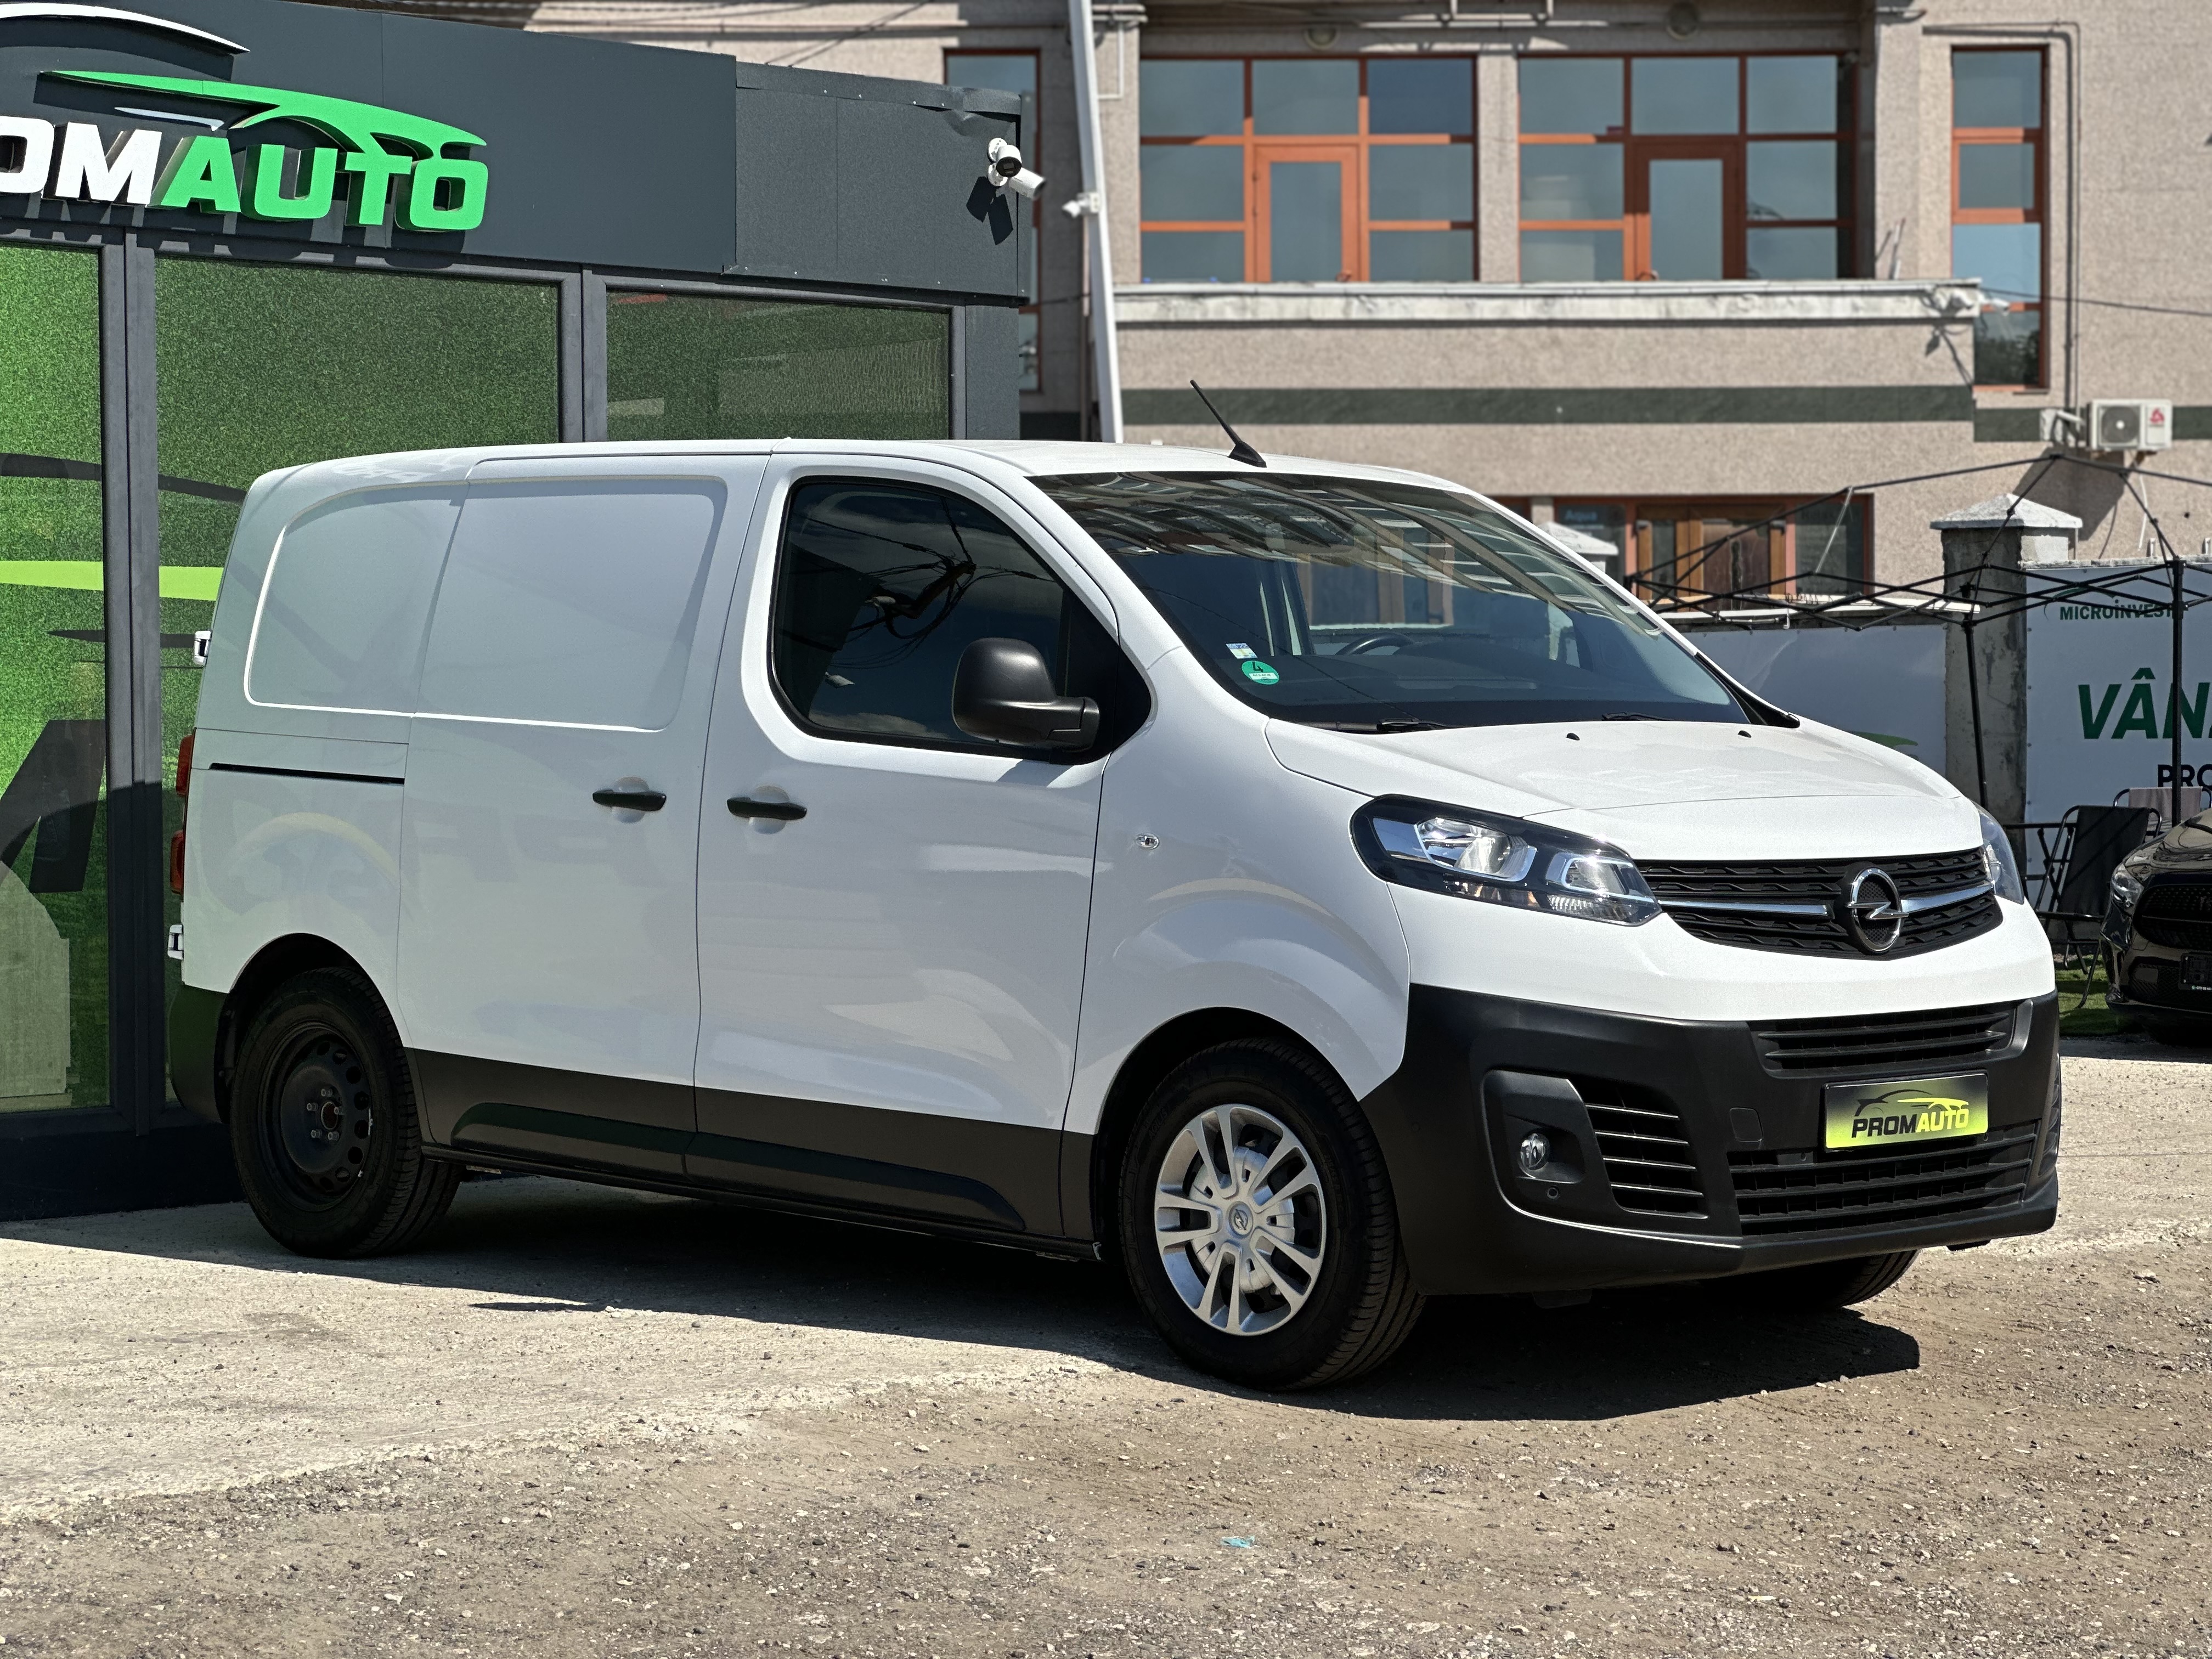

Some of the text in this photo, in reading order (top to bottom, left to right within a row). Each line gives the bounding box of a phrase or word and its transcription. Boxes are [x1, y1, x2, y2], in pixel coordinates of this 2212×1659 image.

[1252, 661, 1264, 673] 4
[2078, 667, 2212, 739] VÂN
[1852, 1108, 1969, 1138] PROMAUTO
